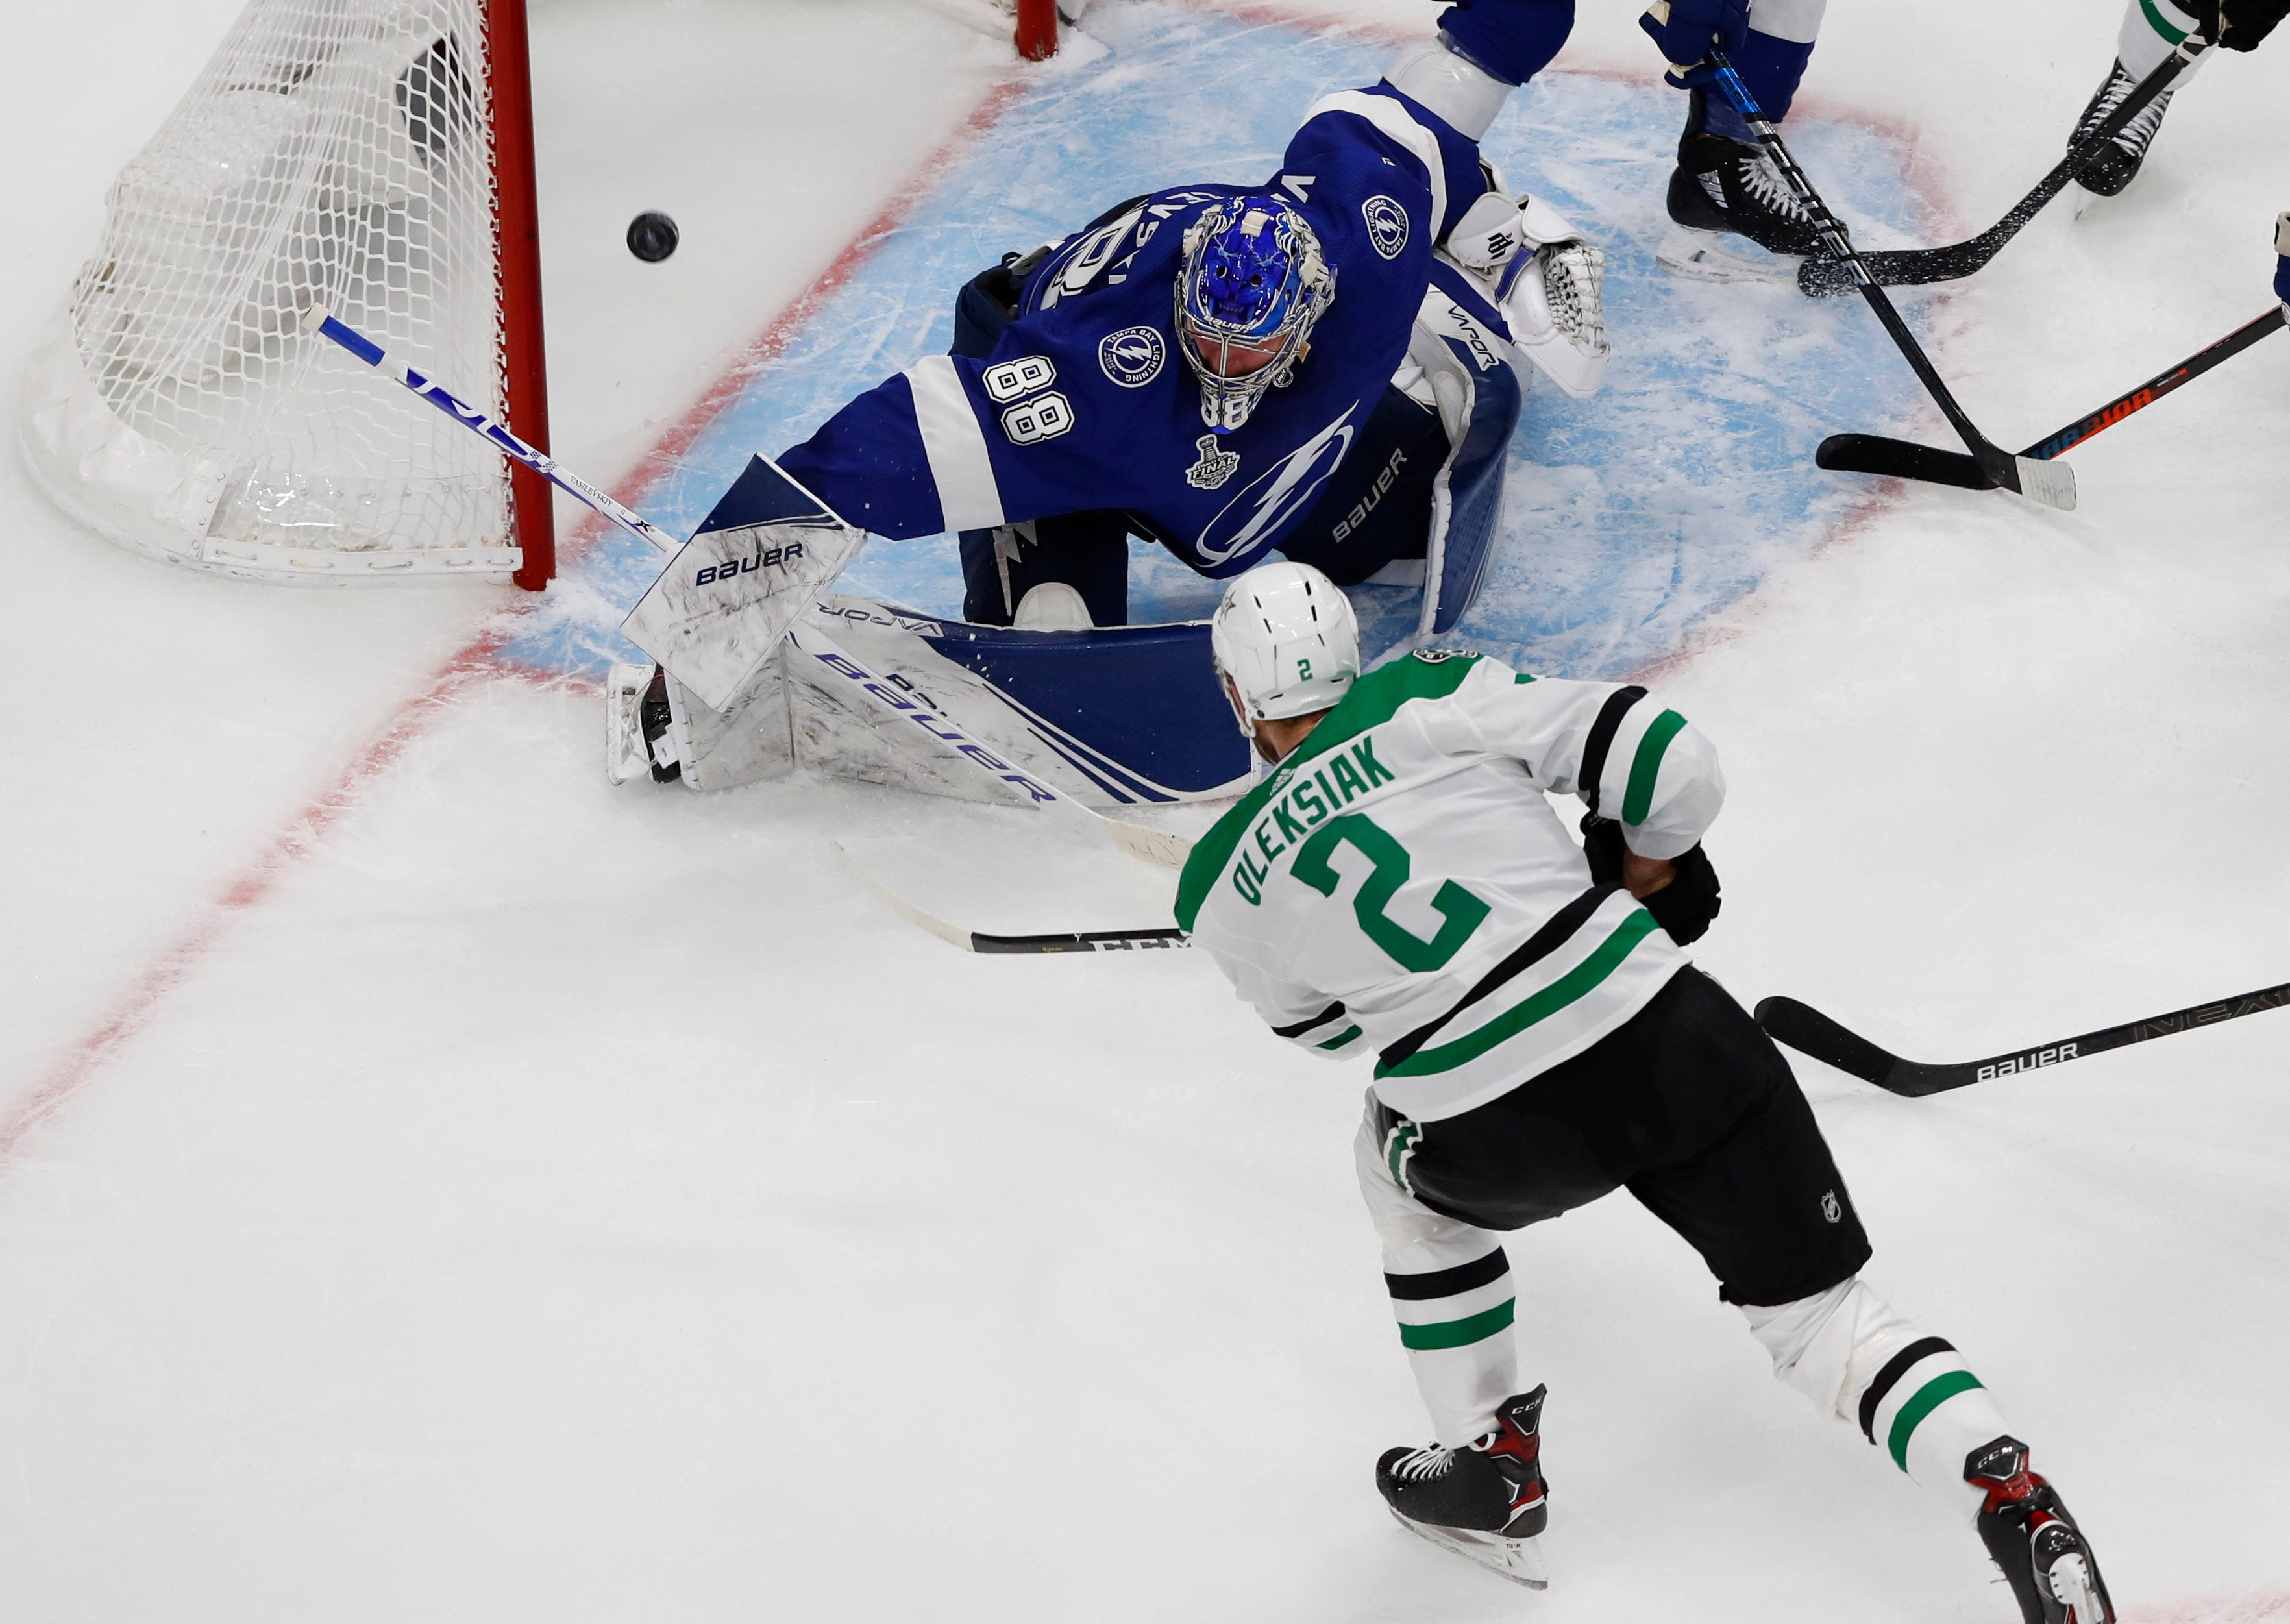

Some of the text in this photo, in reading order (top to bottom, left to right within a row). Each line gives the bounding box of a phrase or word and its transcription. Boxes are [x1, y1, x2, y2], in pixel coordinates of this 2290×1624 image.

[1367, 199, 1387, 232] LIGHTNING
[1375, 236, 1385, 251] BAY
[1203, 315, 1253, 333] BAUER
[1447, 305, 1500, 371] VAPOR
[1107, 329, 1160, 382] TAMPA BAY LIGHTNING
[982, 356, 1075, 446] 88
[1192, 457, 1235, 479] FINAL
[569, 476, 613, 507] VASILEVSKIY
[1332, 447, 1408, 544] BAUER
[696, 543, 804, 587] BAUER
[817, 602, 942, 637] VAPOR
[1297, 659, 1312, 681] 2
[815, 653, 1056, 803] BAUER
[1233, 735, 1396, 906] OLEKSIAK
[1290, 813, 1491, 973] 2
[1977, 1042, 2078, 1083] BAUER
[1978, 1446, 2013, 1470] CCM
